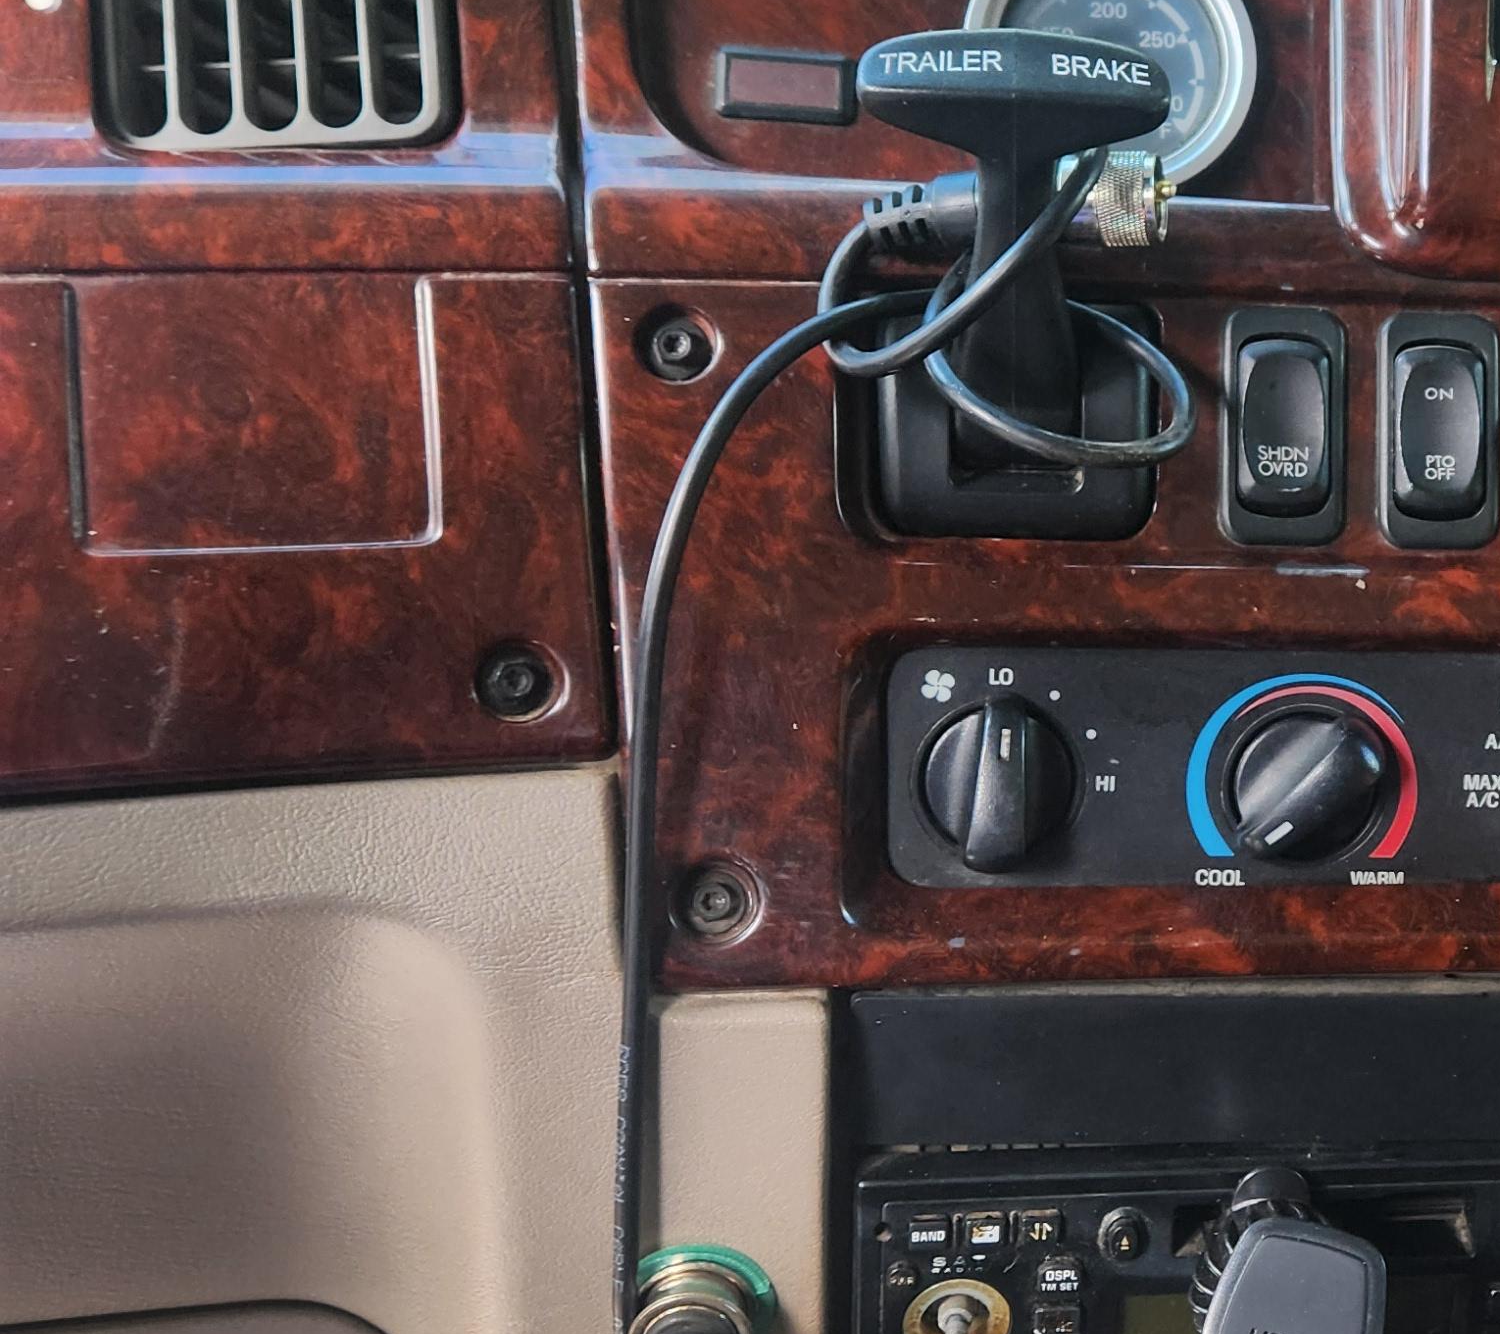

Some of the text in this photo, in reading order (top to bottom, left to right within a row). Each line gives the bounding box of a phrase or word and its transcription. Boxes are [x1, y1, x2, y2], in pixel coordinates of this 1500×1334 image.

[1089, 1, 1128, 19] 200
[1138, 30, 1176, 49] 250
[879, 48, 1152, 86] TRAILER BRAKE
[1424, 387, 1455, 401] ON
[1257, 444, 1310, 463] SHDN
[1425, 454, 1456, 469] PTO
[1257, 460, 1309, 479] OVRD
[1424, 467, 1456, 482] OFF
[988, 668, 1014, 687] LO
[1095, 774, 1117, 793] HI
[1466, 791, 1500, 809] A/C
[1194, 868, 1246, 888] COOL
[1350, 870, 1406, 886] WARM
[911, 1229, 946, 1243] BAND
[1044, 1270, 1079, 1282] DSPL
[1040, 1282, 1079, 1292] TM SET
